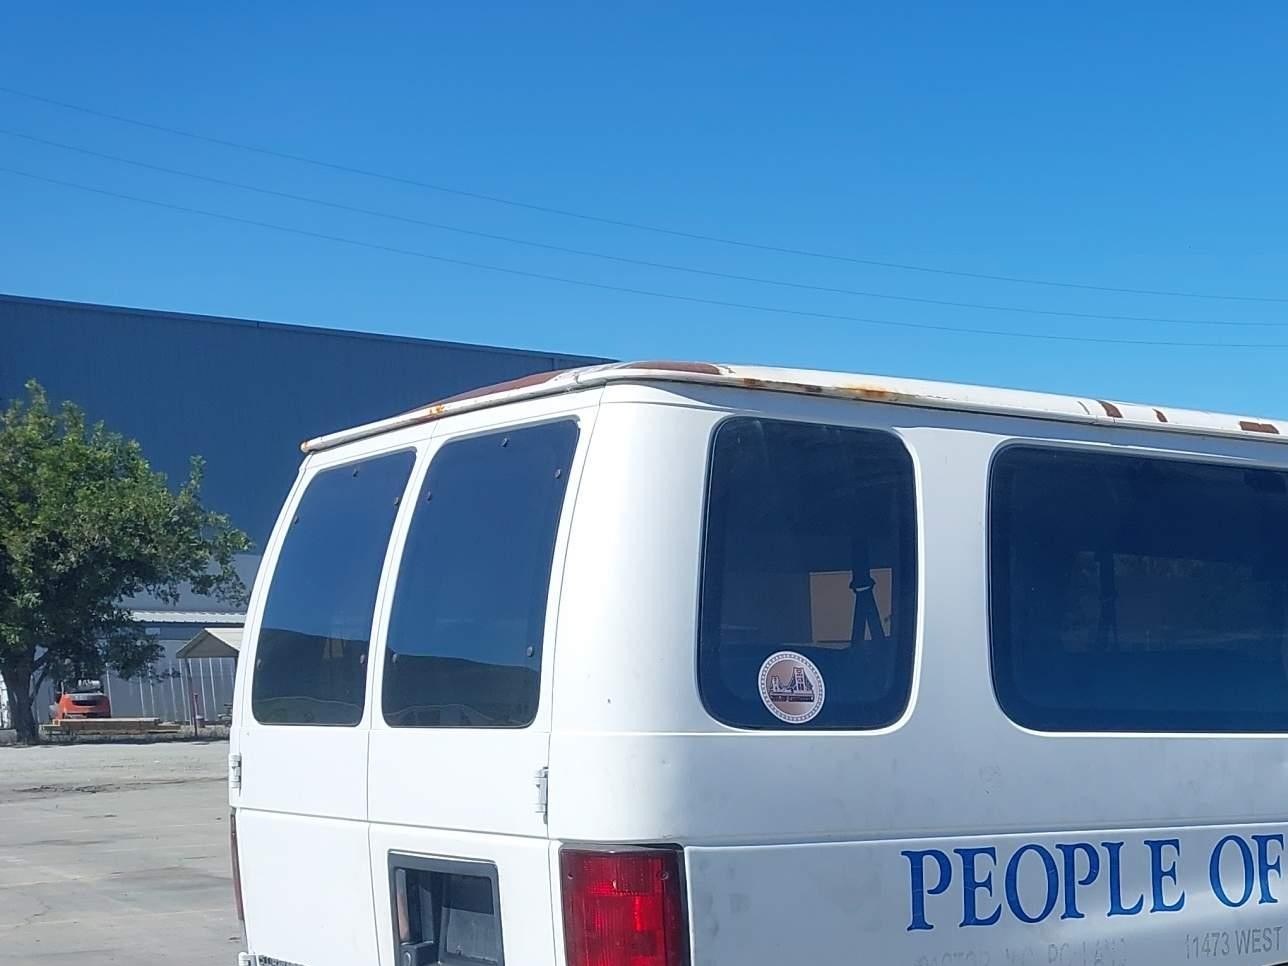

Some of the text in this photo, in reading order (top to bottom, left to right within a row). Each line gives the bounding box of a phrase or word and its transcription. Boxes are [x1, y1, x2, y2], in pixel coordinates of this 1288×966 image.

[901, 838, 1185, 932] PEOPLE
[1209, 833, 1285, 908] OF
[1234, 926, 1283, 956] WEST
